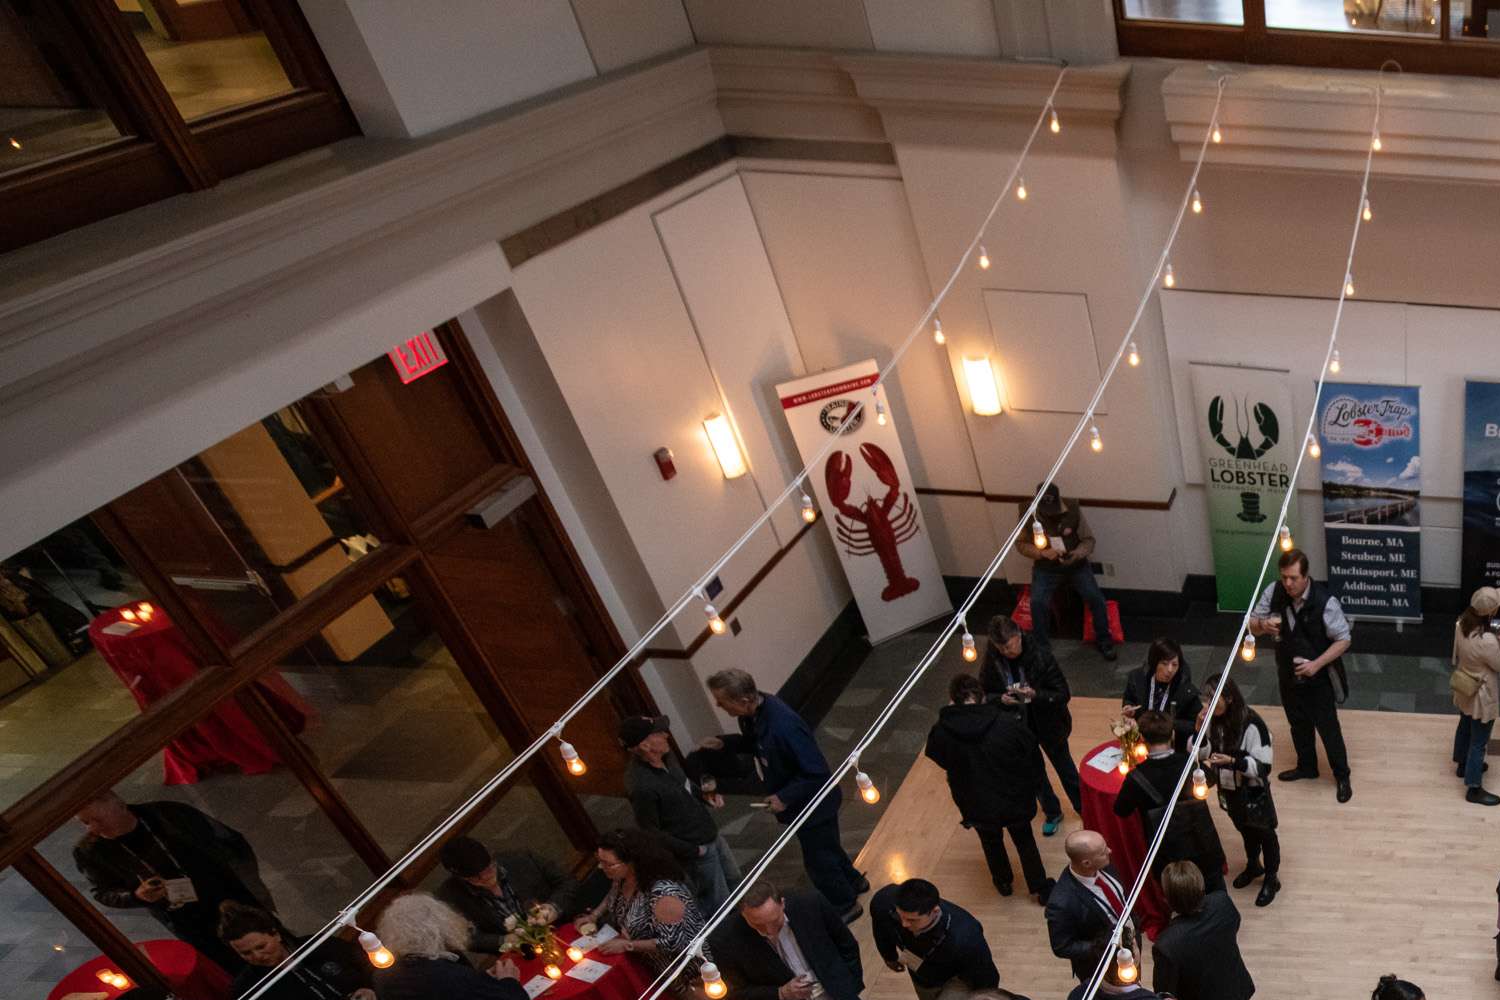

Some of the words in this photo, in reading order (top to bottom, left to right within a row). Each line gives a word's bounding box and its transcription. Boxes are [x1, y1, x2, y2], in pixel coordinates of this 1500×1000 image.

[396, 332, 439, 374] EXIT
[1328, 402, 1379, 427] Lobster
[1208, 457, 1288, 473] GREENHEAD
[1210, 468, 1290, 488] LOBSTER
[1341, 535, 1383, 547] Bourne,
[1386, 537, 1404, 547] MA
[1341, 551, 1386, 562] Steuben,
[1389, 553, 1406, 562] ME
[1400, 569, 1416, 578] ME
[1343, 581, 1387, 592] Addison,
[1390, 583, 1406, 592] ME
[1340, 595, 1389, 606] Chatham,
[1392, 597, 1409, 607] MA
